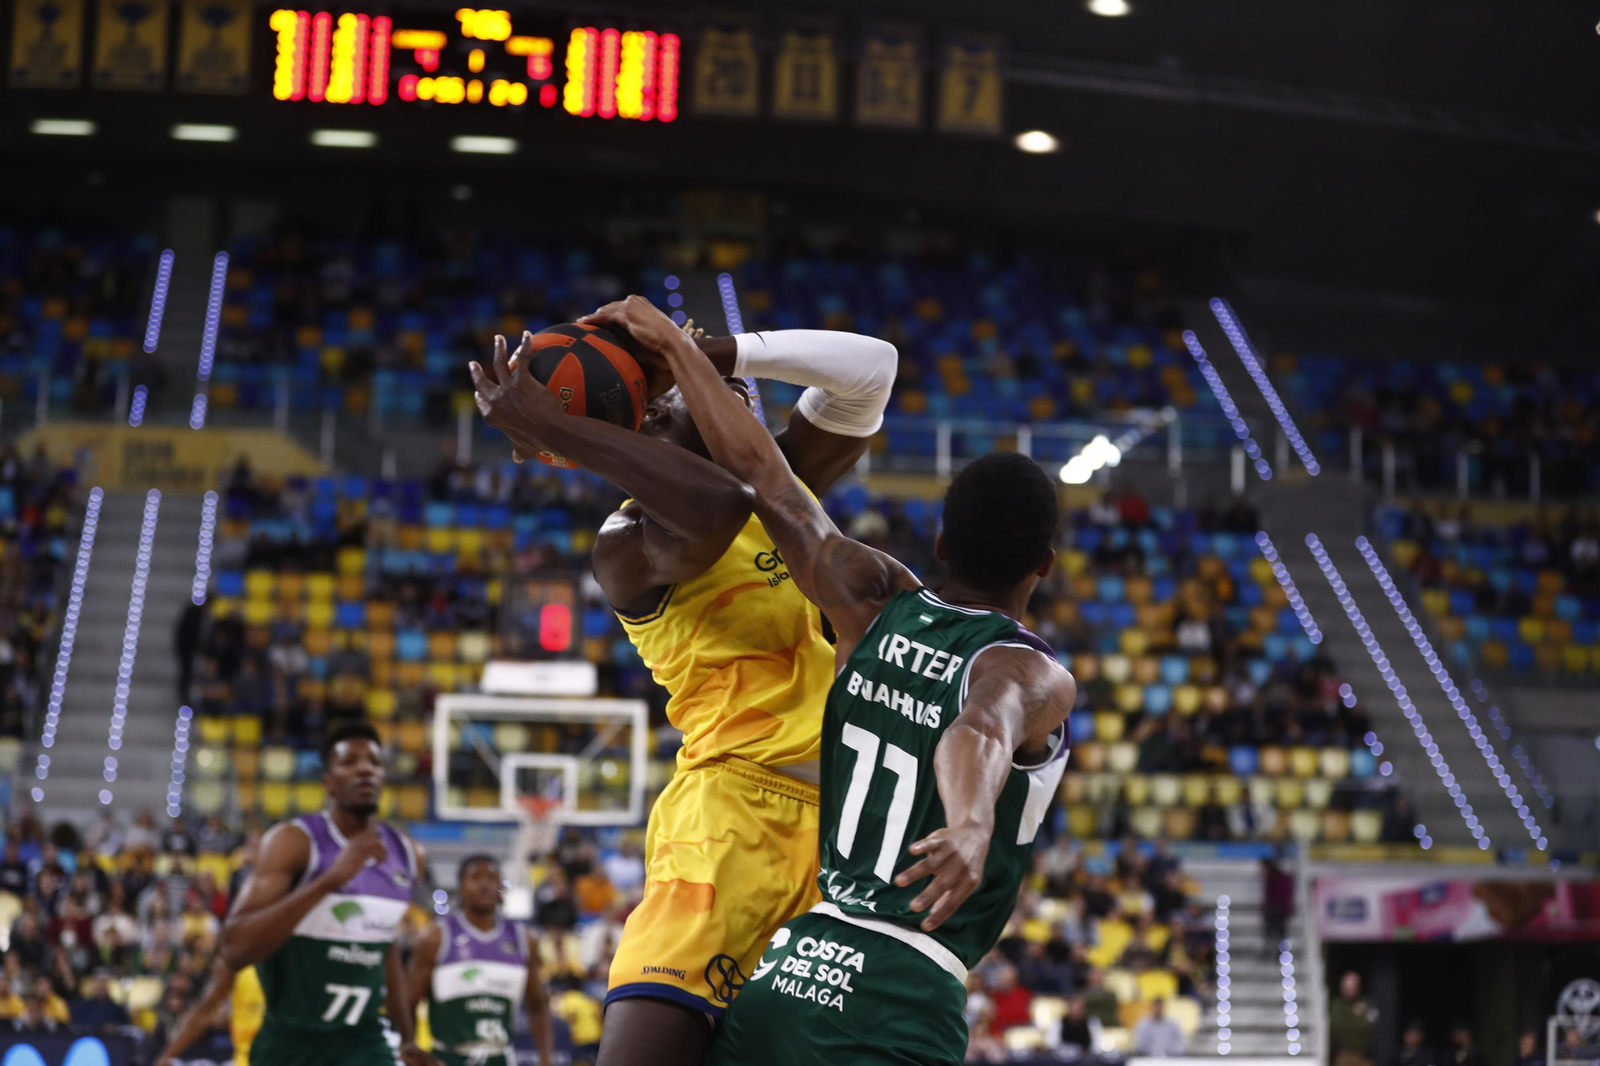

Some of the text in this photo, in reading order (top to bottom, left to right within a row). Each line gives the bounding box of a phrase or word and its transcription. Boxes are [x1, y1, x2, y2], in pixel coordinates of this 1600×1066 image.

[754, 547, 785, 573] Gr
[780, 954, 854, 993] DEL SOL
[796, 936, 865, 974] COSTA
[321, 983, 372, 1026] 77
[771, 974, 844, 1013] MALAGA
